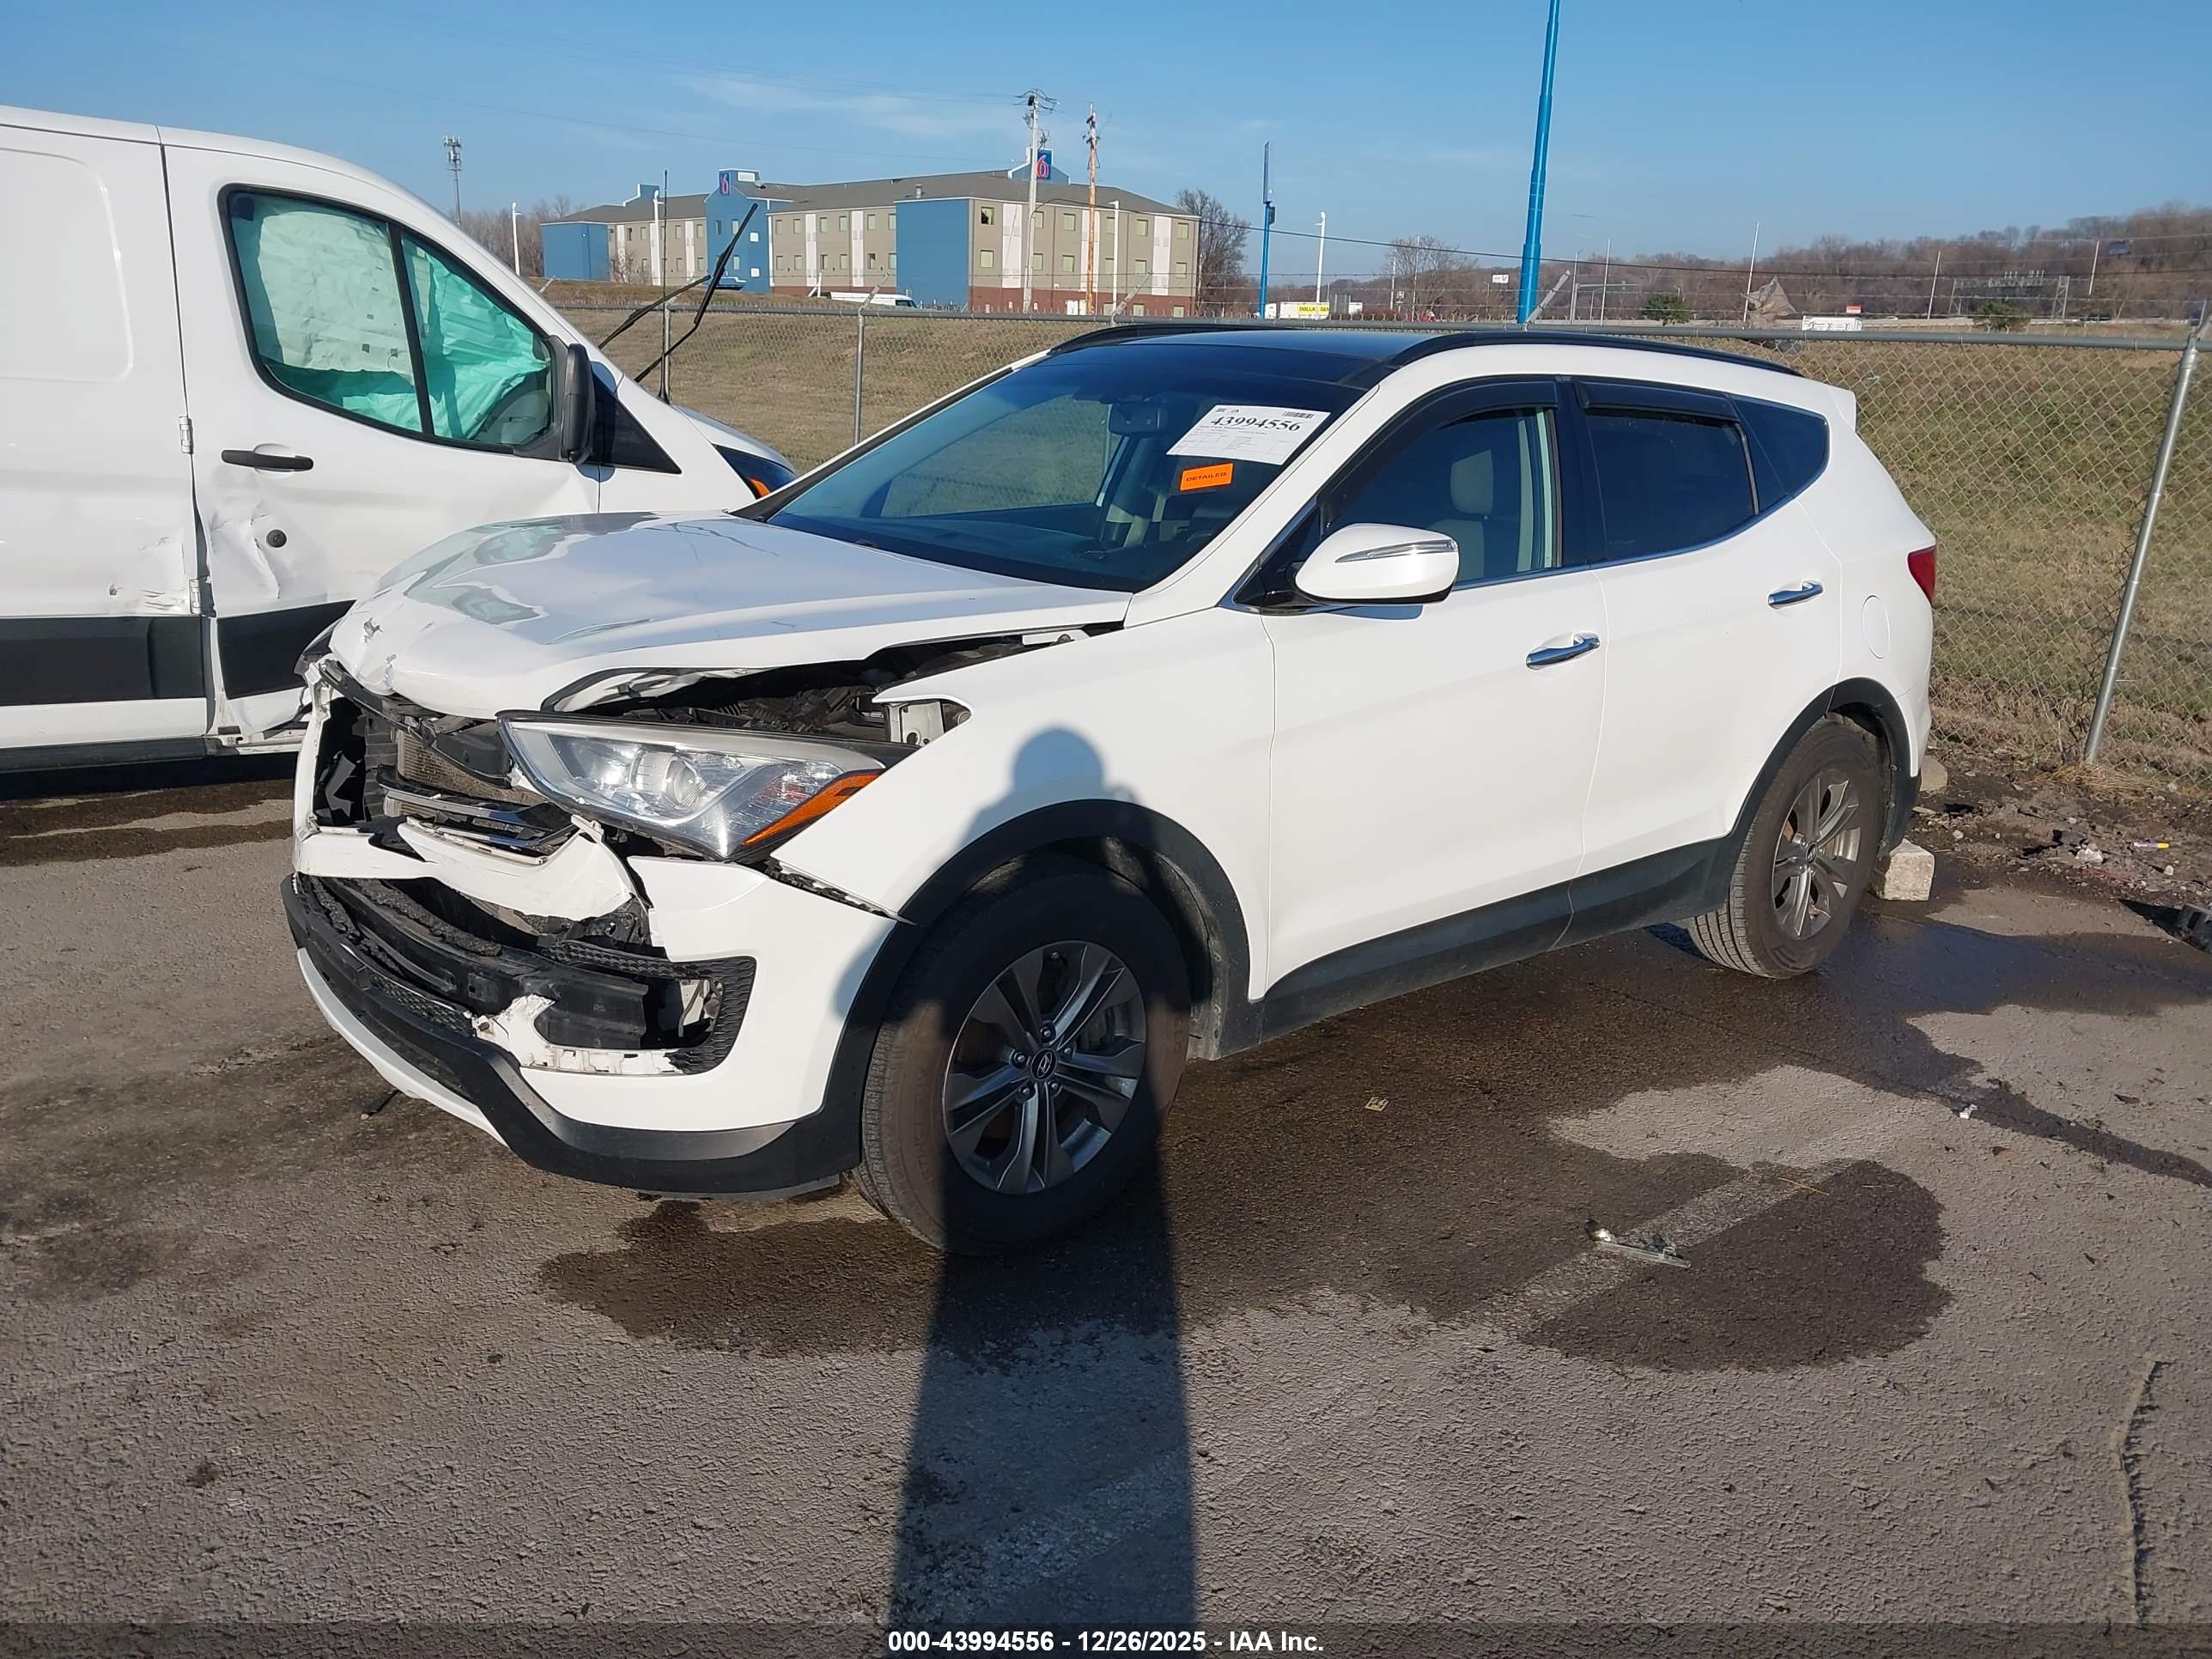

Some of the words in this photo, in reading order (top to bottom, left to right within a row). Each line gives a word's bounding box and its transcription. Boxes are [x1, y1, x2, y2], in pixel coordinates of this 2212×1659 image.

[1036, 155, 1049, 179] 6
[720, 173, 729, 195] 6
[1211, 416, 1304, 432] 43994556
[1186, 472, 1227, 482] DETAILED
